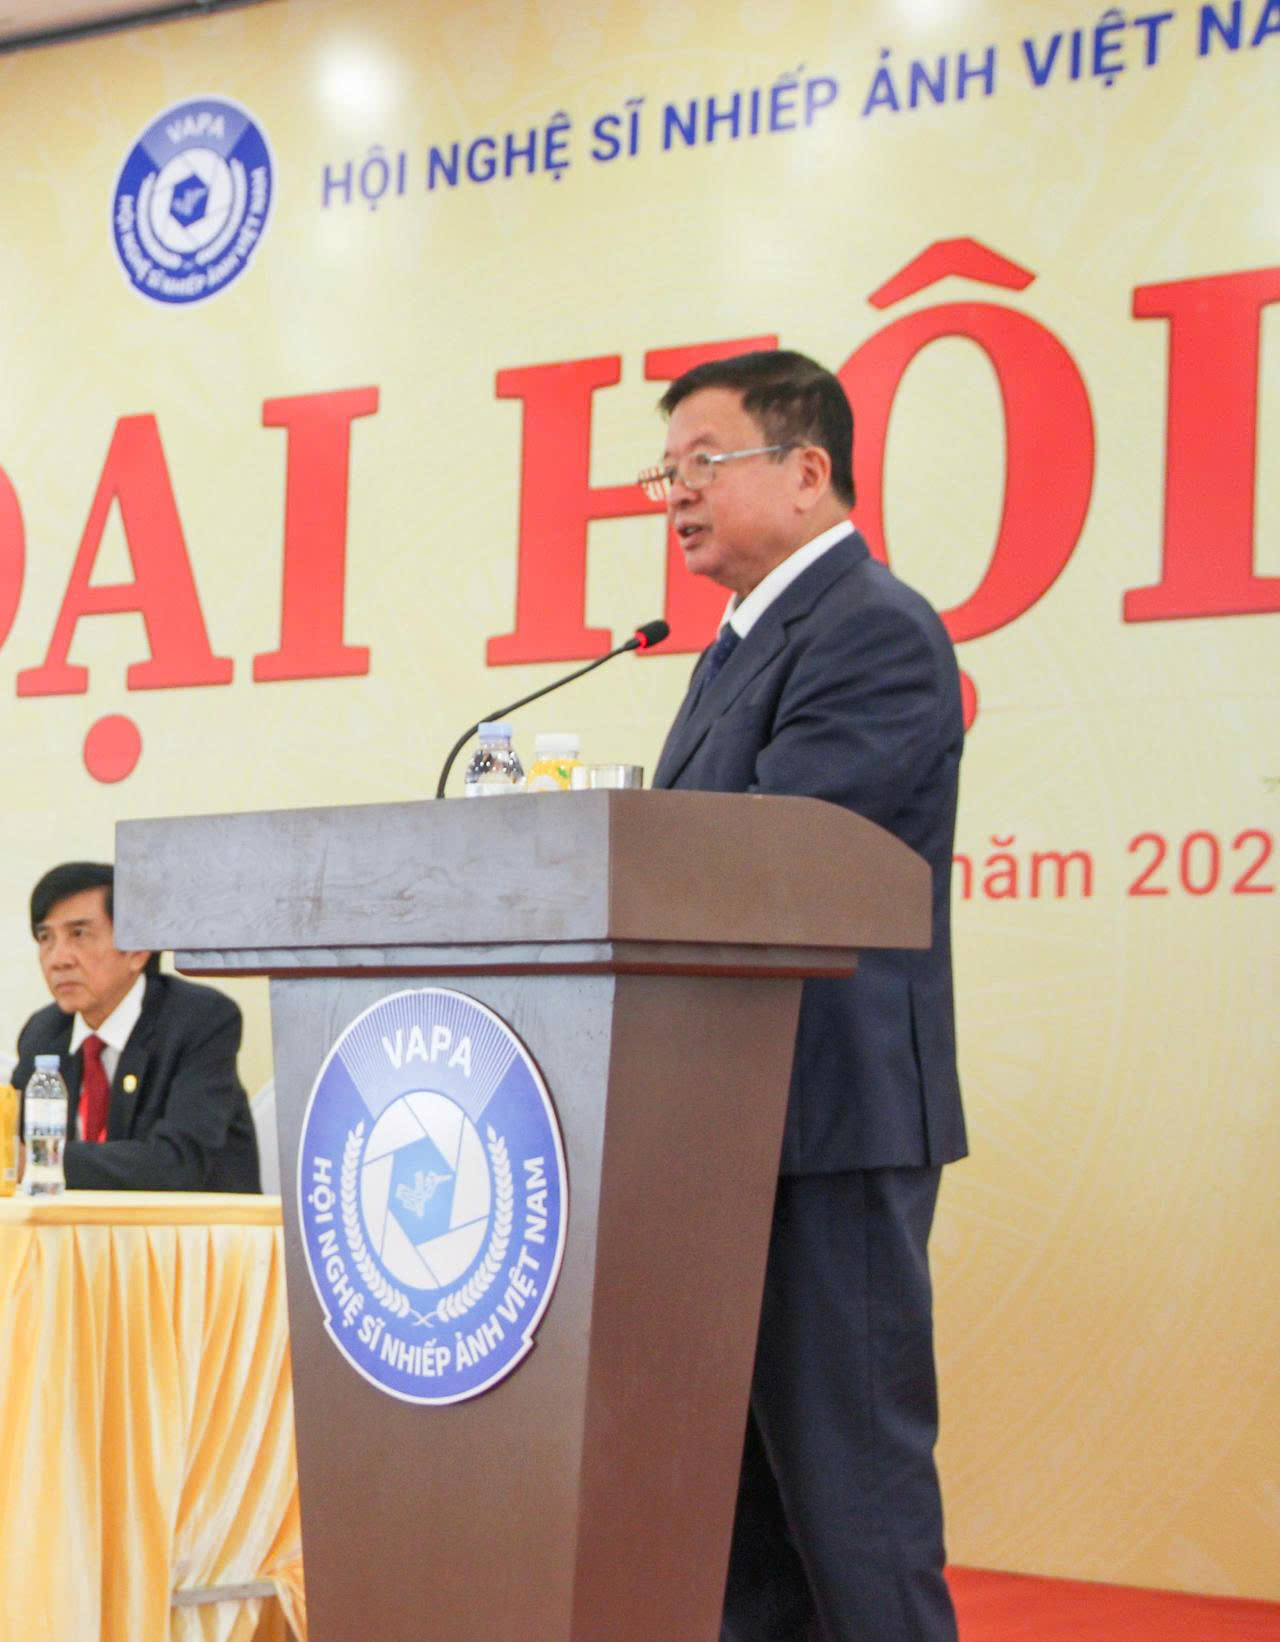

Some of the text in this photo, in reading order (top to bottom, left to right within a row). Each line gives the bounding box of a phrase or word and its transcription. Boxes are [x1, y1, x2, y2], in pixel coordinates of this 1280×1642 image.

[321, 144, 409, 210] HỘI
[426, 111, 572, 190] NGHỆ
[591, 97, 644, 161] SĨ
[663, 64, 840, 152] NHIẾP
[863, 48, 997, 117] ẢNH
[1023, 9, 1175, 88] VIỆT
[485, 236, 1280, 733] HỘI
[382, 1025, 473, 1078] VAPA
[308, 1156, 548, 1377] HỘI NGHỆ SĨ NHIẾP ẢNH VIỆT NAM
